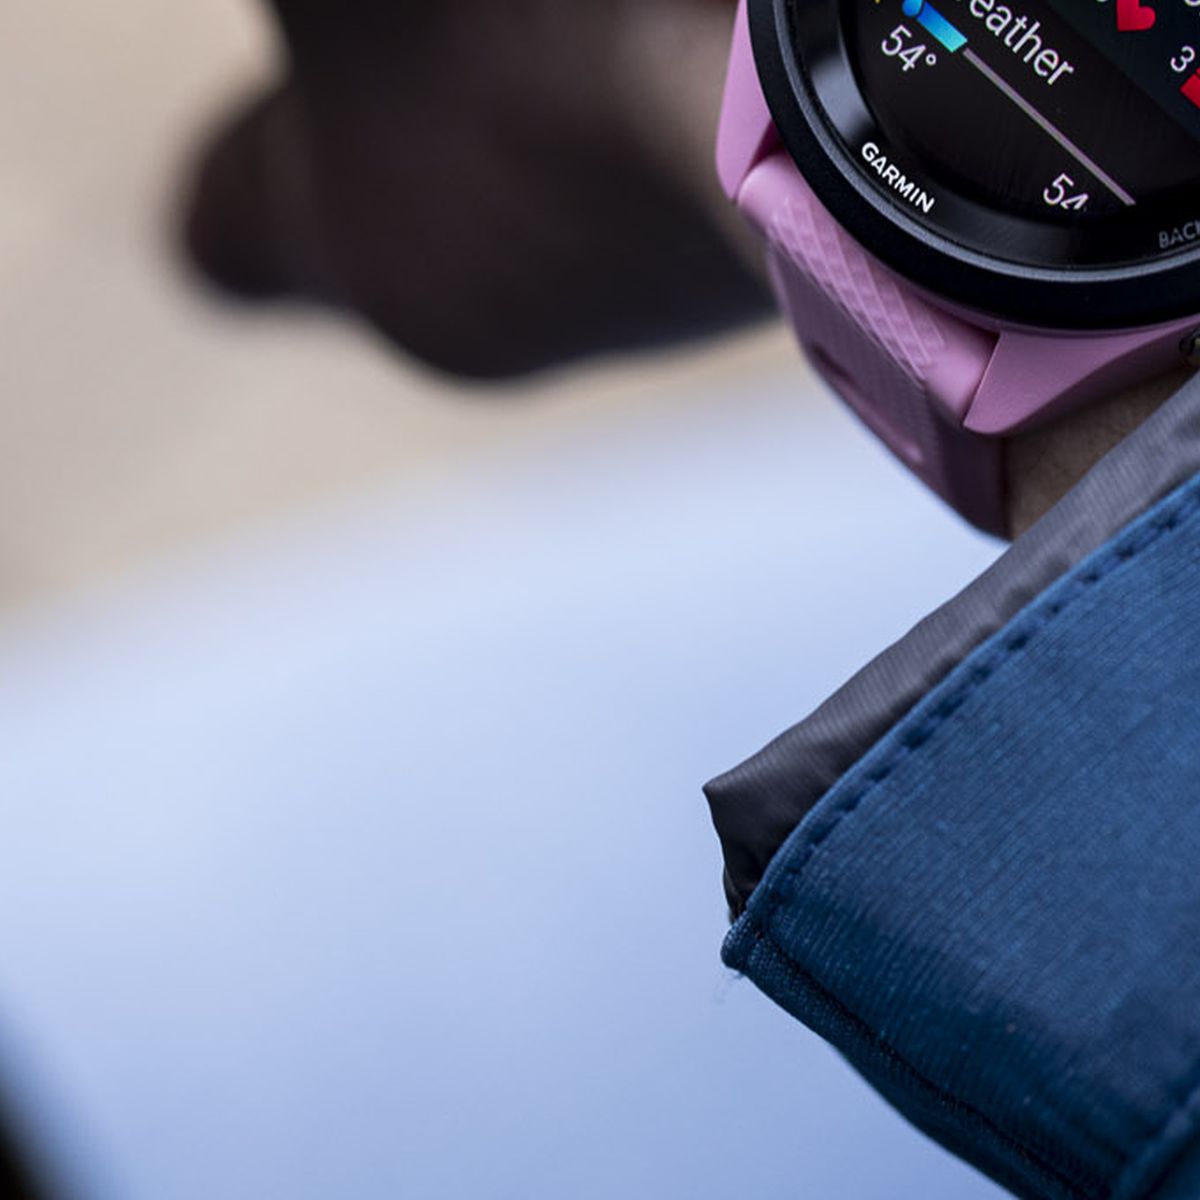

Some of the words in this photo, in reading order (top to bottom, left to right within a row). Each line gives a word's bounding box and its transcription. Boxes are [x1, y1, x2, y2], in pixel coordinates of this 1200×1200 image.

[881, 25, 937, 72] 54°
[1170, 46, 1195, 72] 3
[861, 142, 936, 213] GARMIN
